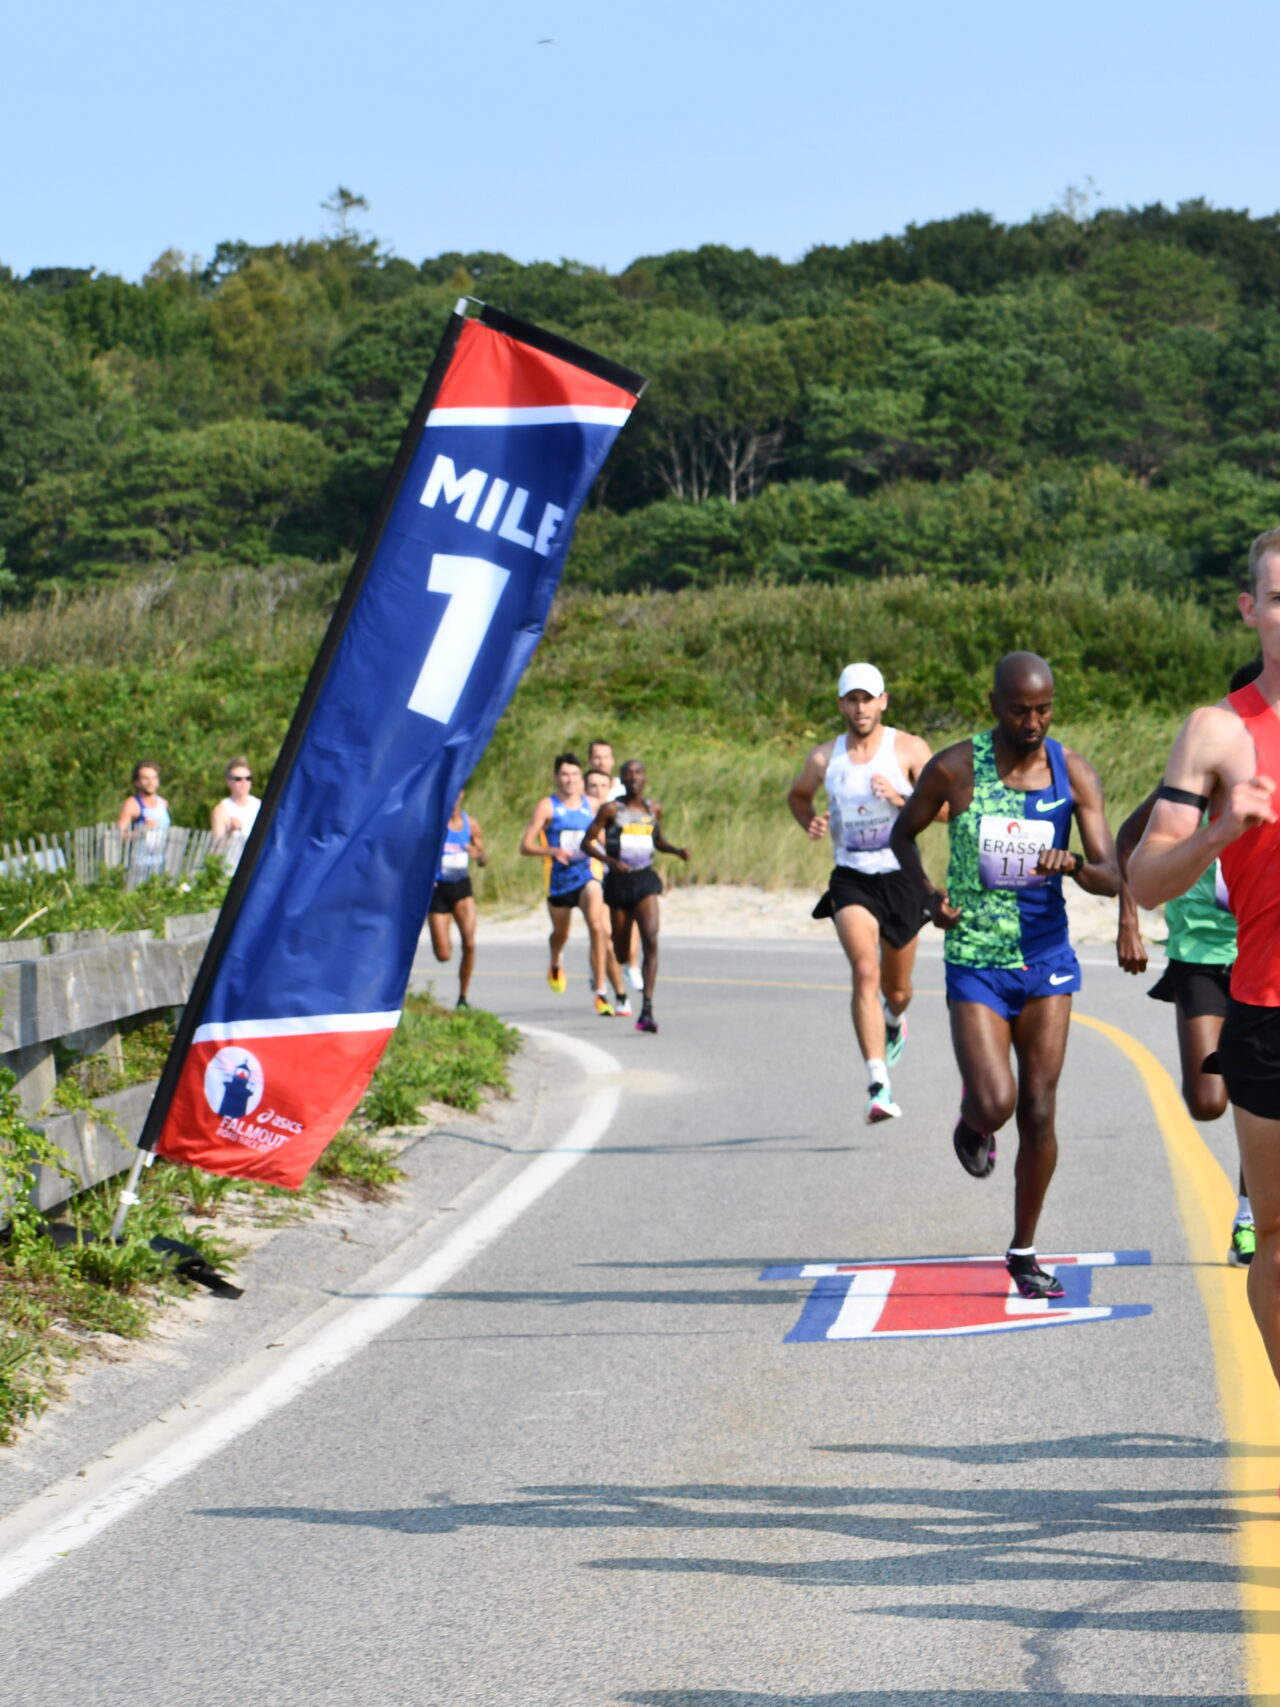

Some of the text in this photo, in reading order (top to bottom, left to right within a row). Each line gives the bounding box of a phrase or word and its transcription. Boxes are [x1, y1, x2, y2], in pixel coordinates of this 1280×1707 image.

[419, 454, 565, 556] MILE
[406, 553, 512, 725] 1
[982, 838, 1047, 856] ERASSA
[1000, 857, 1025, 877] 11
[220, 1114, 291, 1149] FALMOUT
[270, 1114, 305, 1135] asics
